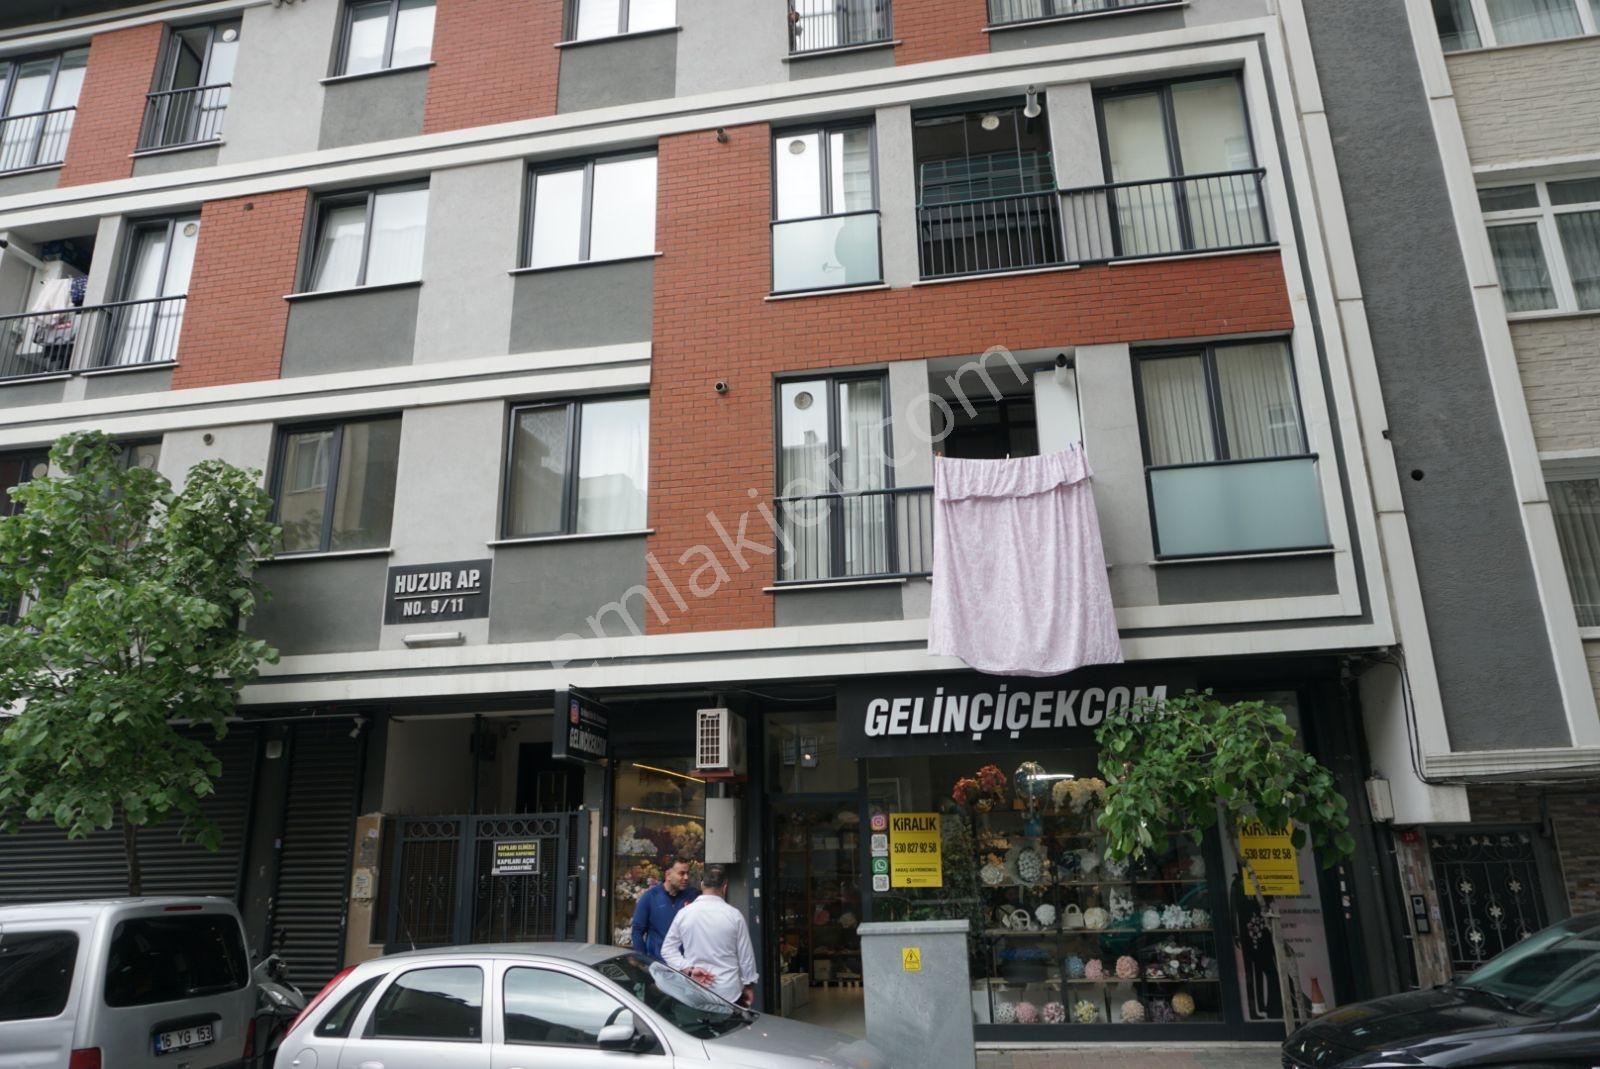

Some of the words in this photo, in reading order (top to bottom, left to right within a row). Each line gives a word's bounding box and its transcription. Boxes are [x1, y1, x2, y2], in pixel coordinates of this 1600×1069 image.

[394, 571, 452, 593] HUZUR
[456, 569, 480, 589] AP.
[403, 600, 426, 616] NO.
[431, 598, 464, 614] 9/11
[864, 684, 1167, 741] GELİNÇİÇEKCOM
[894, 842, 906, 853] 530
[907, 842, 919, 853] 827
[920, 842, 928, 853] 92
[929, 842, 937, 853] 58
[1259, 848, 1271, 859] 827
[1272, 848, 1281, 859] 92
[1282, 848, 1292, 859] 58
[161, 1032, 171, 1048] 16
[177, 1030, 192, 1045] YG
[197, 1025, 211, 1041] 153
